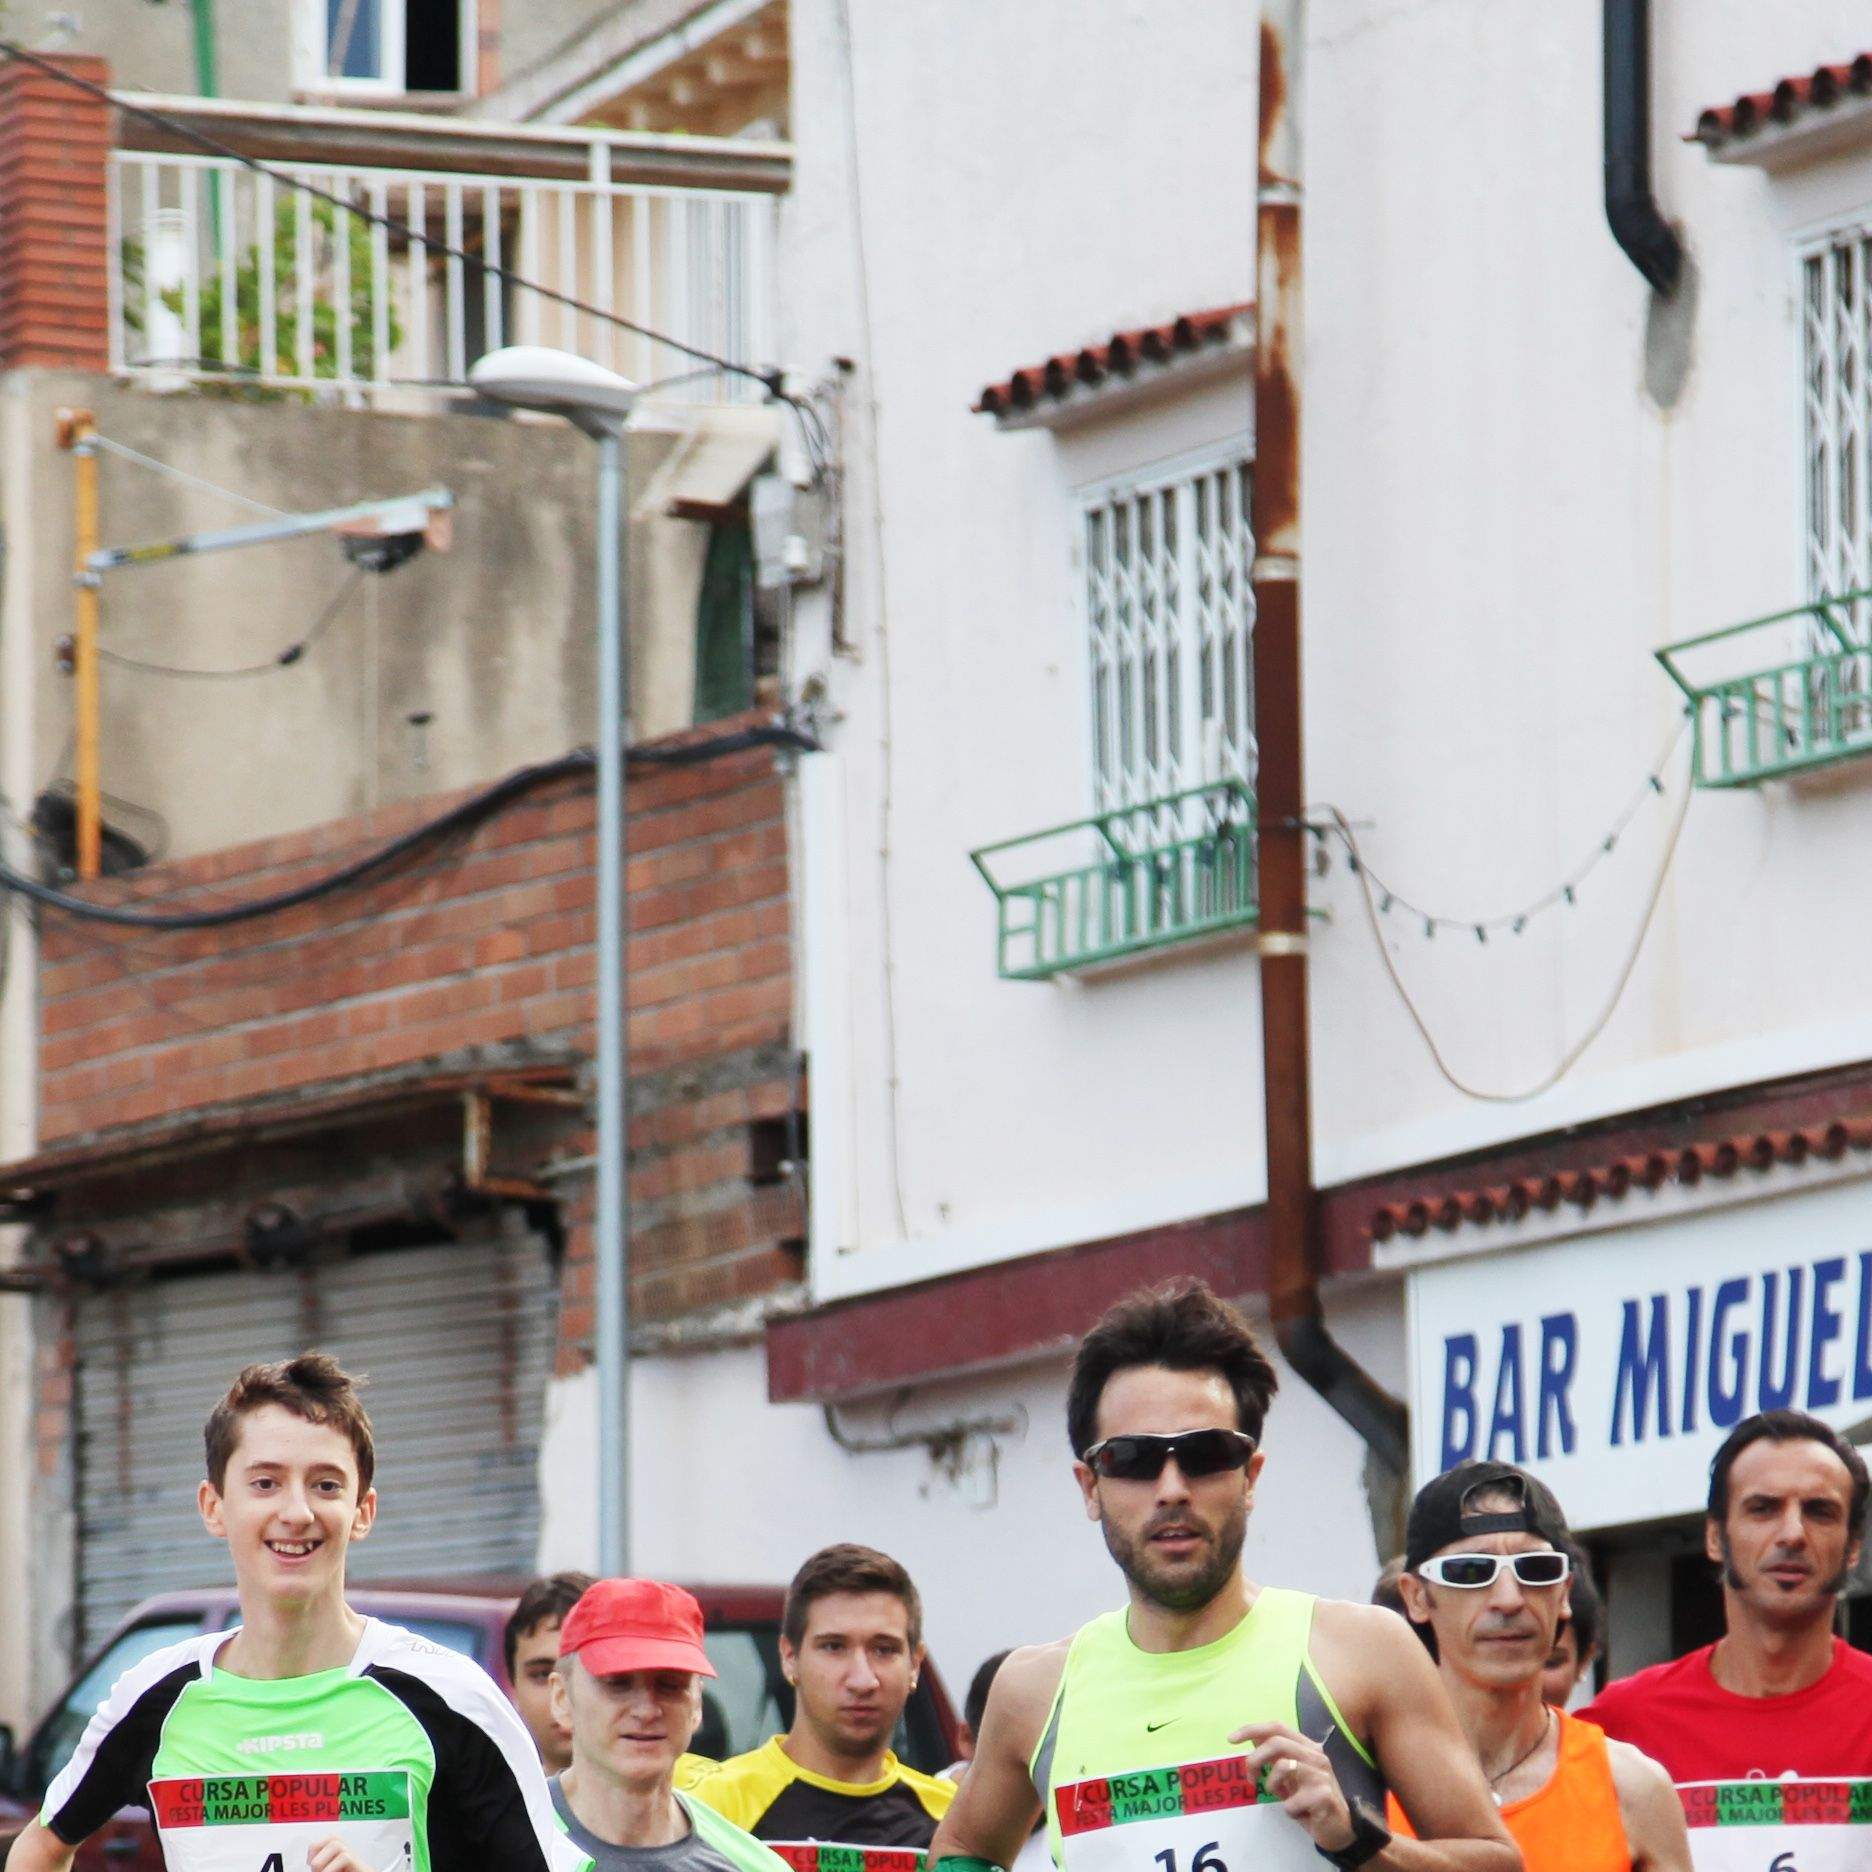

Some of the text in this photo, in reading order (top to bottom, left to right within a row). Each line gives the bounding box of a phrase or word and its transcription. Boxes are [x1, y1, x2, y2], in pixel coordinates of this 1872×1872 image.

[1440, 1311, 1578, 1473] BAR
[179, 1776, 368, 1803] CURSA POPULAR
[1083, 1760, 1266, 1805] CURSA POPUL
[1123, 1795, 1185, 1818] MAJOR
[1193, 1790, 1225, 1807] LES
[1691, 1785, 1764, 1806] CURSA
[214, 1802, 272, 1820] MAJOR
[280, 1801, 309, 1817] LES
[315, 1799, 386, 1816] PLANES
[1687, 1808, 1724, 1823] ESTA
[1729, 1806, 1787, 1822] MAJOR
[858, 1850, 927, 1870] POPULA
